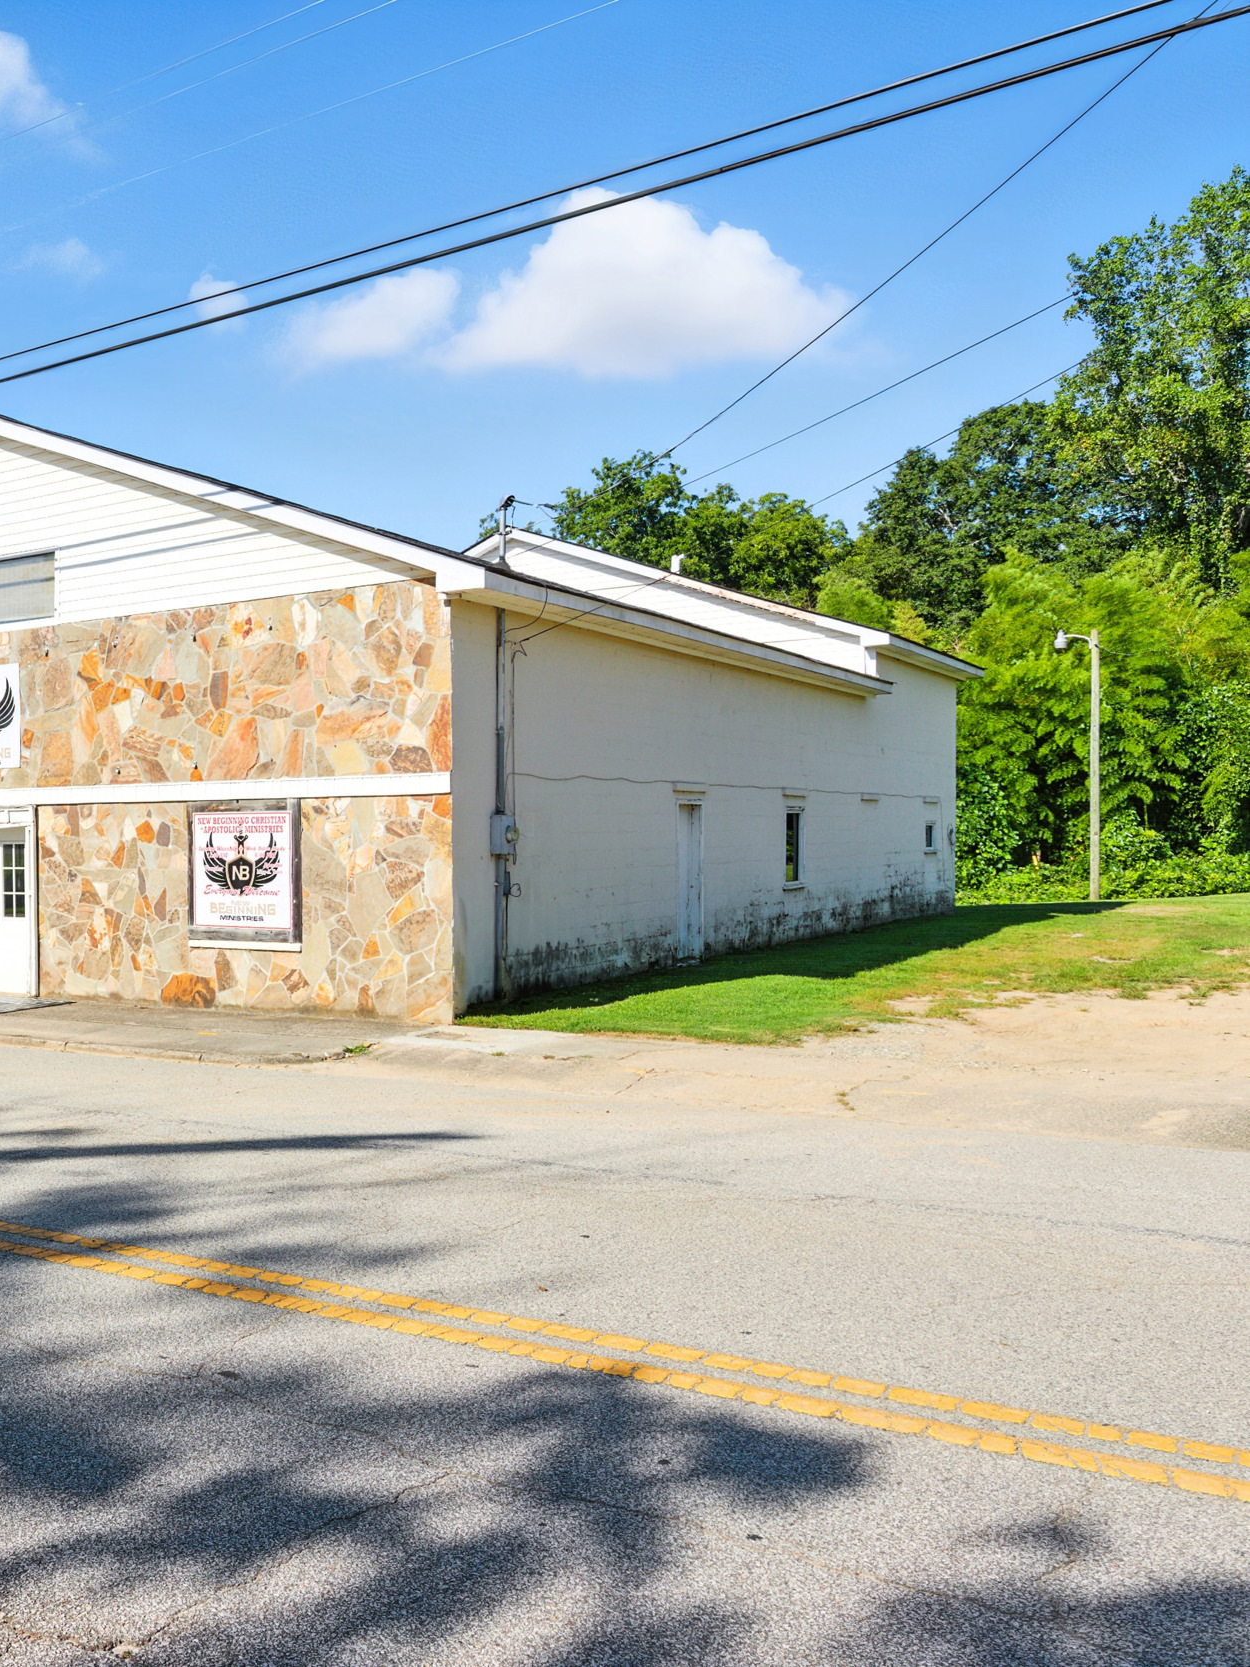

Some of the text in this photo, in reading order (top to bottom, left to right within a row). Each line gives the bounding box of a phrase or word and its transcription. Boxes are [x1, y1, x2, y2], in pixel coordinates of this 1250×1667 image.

[197, 815, 287, 825] NEW BEGINNING CHRISTIAN
[244, 825, 284, 834] MINISTRIES
[232, 865, 250, 881] NB
[209, 902, 277, 916] BEGINNING
[219, 914, 264, 922] MINISTRIES
